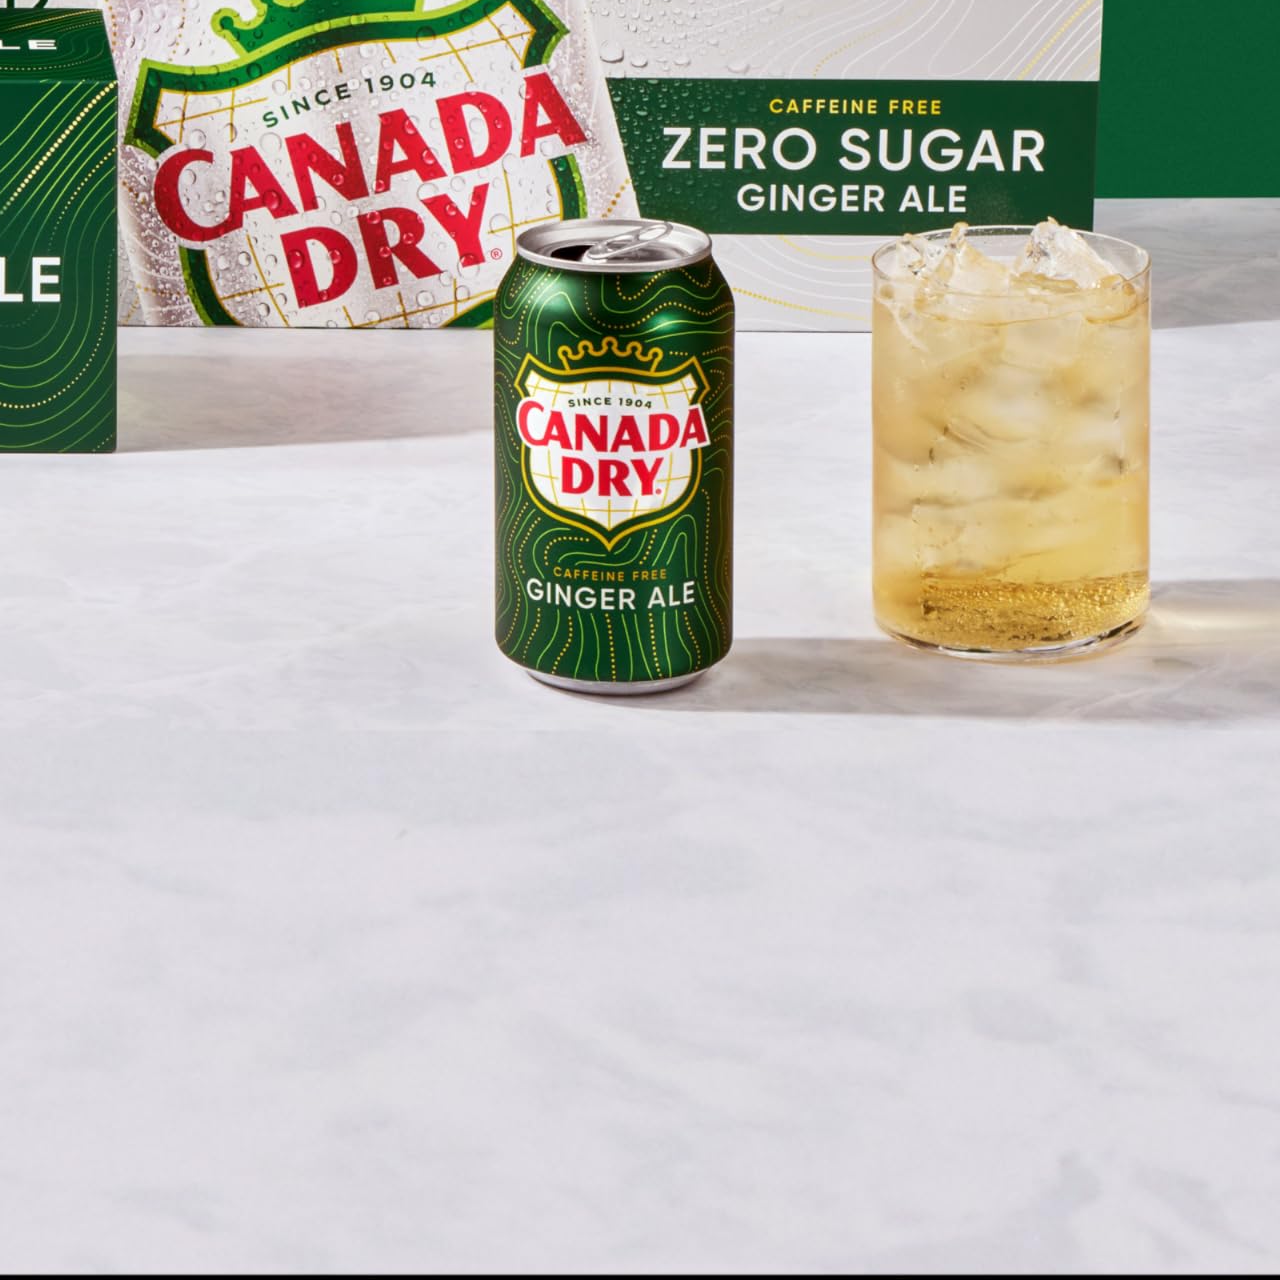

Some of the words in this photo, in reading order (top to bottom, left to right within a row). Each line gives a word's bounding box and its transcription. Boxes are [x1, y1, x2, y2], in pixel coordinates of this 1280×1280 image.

[261, 81, 352, 128] SINCE
[363, 71, 437, 94] 1904
[769, 98, 878, 115] CAFFEINE
[888, 99, 942, 115] FREE
[153, 70, 588, 243] CANADA
[661, 127, 817, 171] ZERO
[838, 127, 1045, 172] SUGAR
[736, 183, 885, 212] GINGER
[898, 185, 968, 213] ALE
[568, 397, 612, 408] SINCE
[619, 397, 653, 409] 1904
[518, 400, 708, 453] CANADA
[561, 456, 664, 497] DRY
[553, 566, 625, 582] CAFFEINE
[633, 568, 667, 581] FREE
[526, 578, 636, 610] GINGER
[647, 581, 695, 609] ALE
